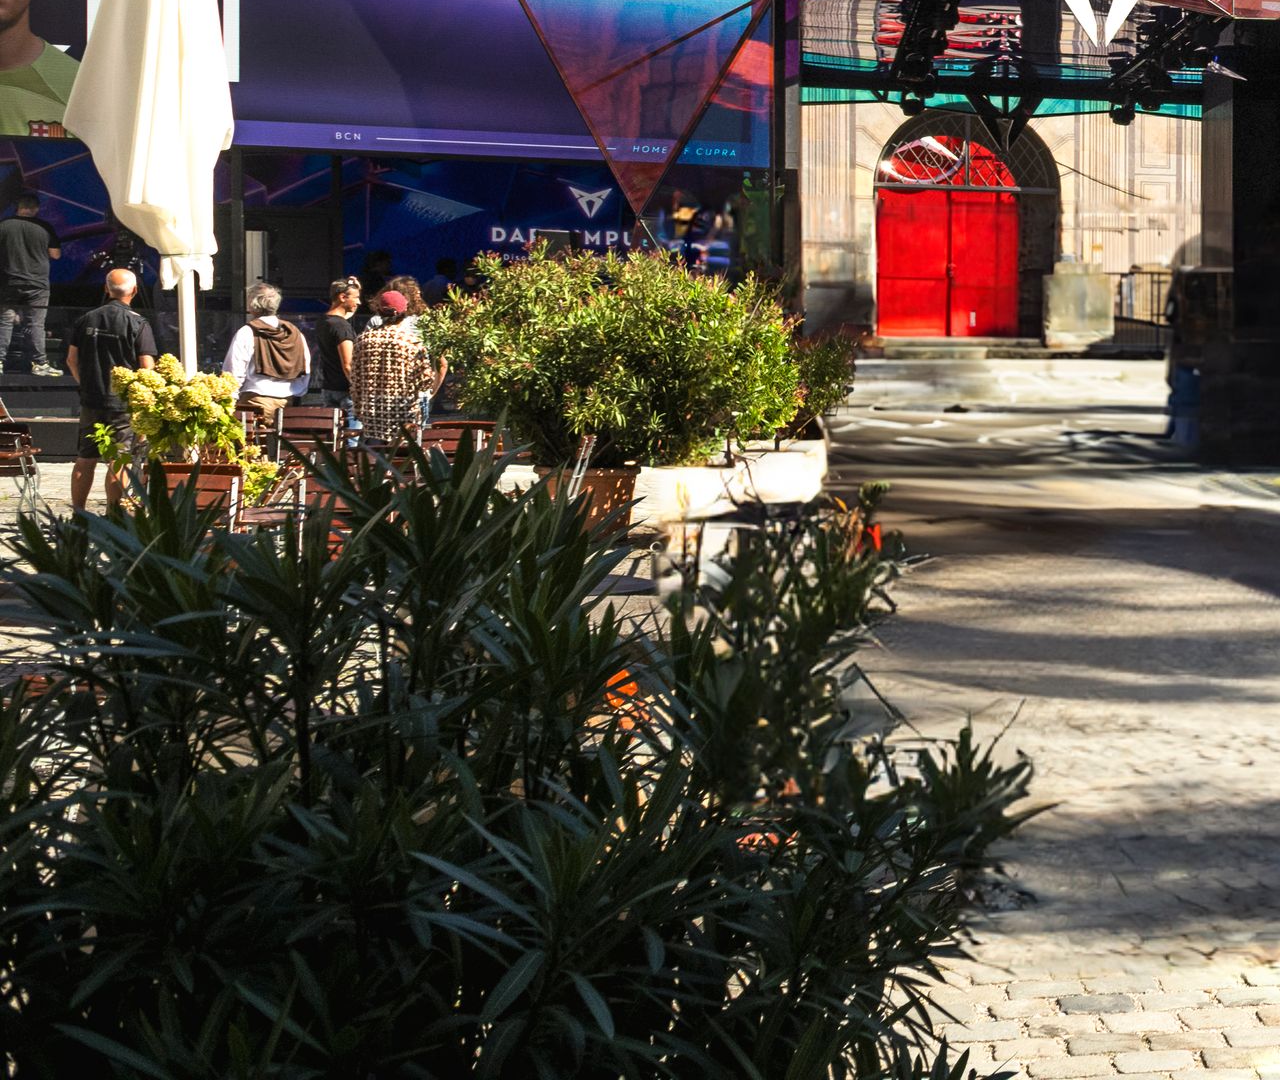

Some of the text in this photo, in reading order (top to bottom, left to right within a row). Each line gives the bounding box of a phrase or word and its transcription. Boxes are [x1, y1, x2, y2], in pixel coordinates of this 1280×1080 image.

[335, 131, 361, 141] BCN
[632, 145, 668, 154] HOME
[695, 148, 737, 157] CUPRA
